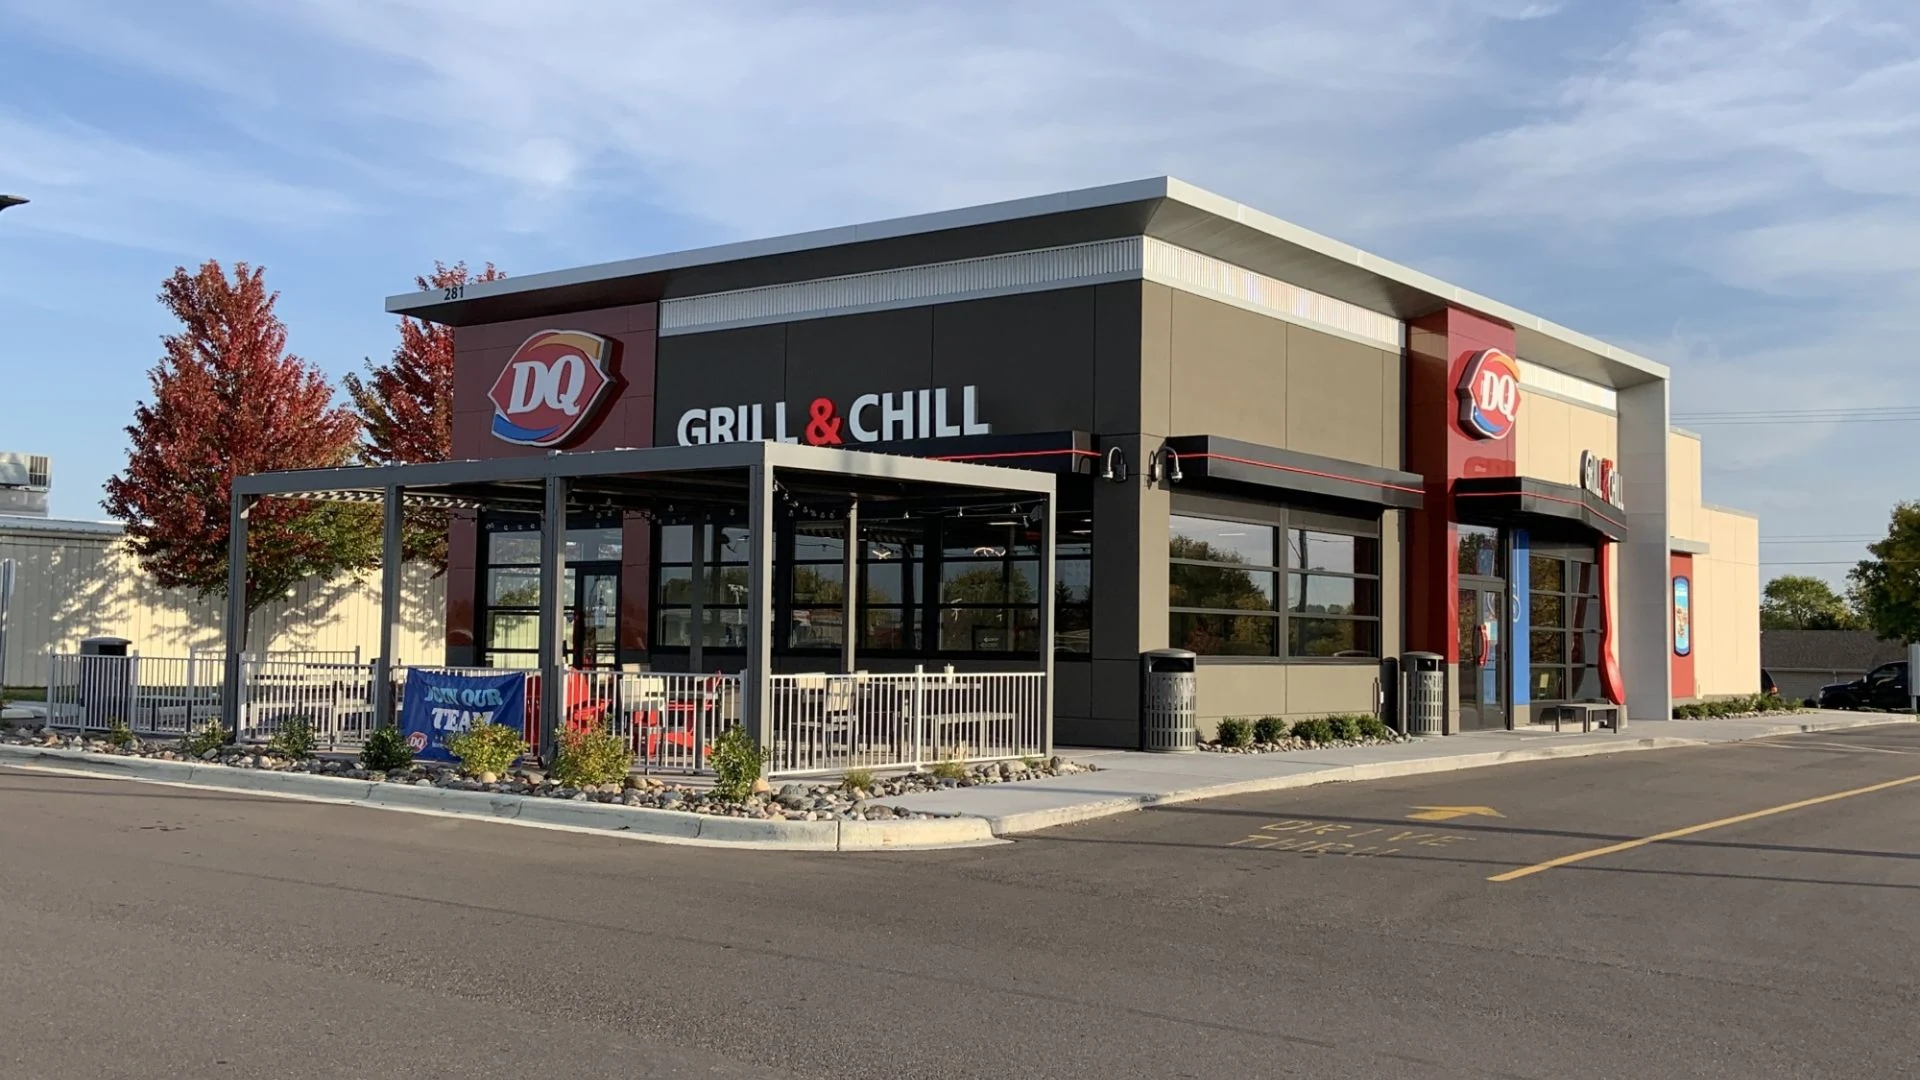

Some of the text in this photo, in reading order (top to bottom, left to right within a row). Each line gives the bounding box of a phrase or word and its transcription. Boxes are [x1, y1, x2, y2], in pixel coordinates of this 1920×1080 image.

[443, 285, 464, 301] 281
[507, 354, 586, 416] DQ
[1480, 369, 1515, 423] DQ
[677, 385, 993, 447] GRILL & CHILL
[461, 688, 503, 708] OUR
